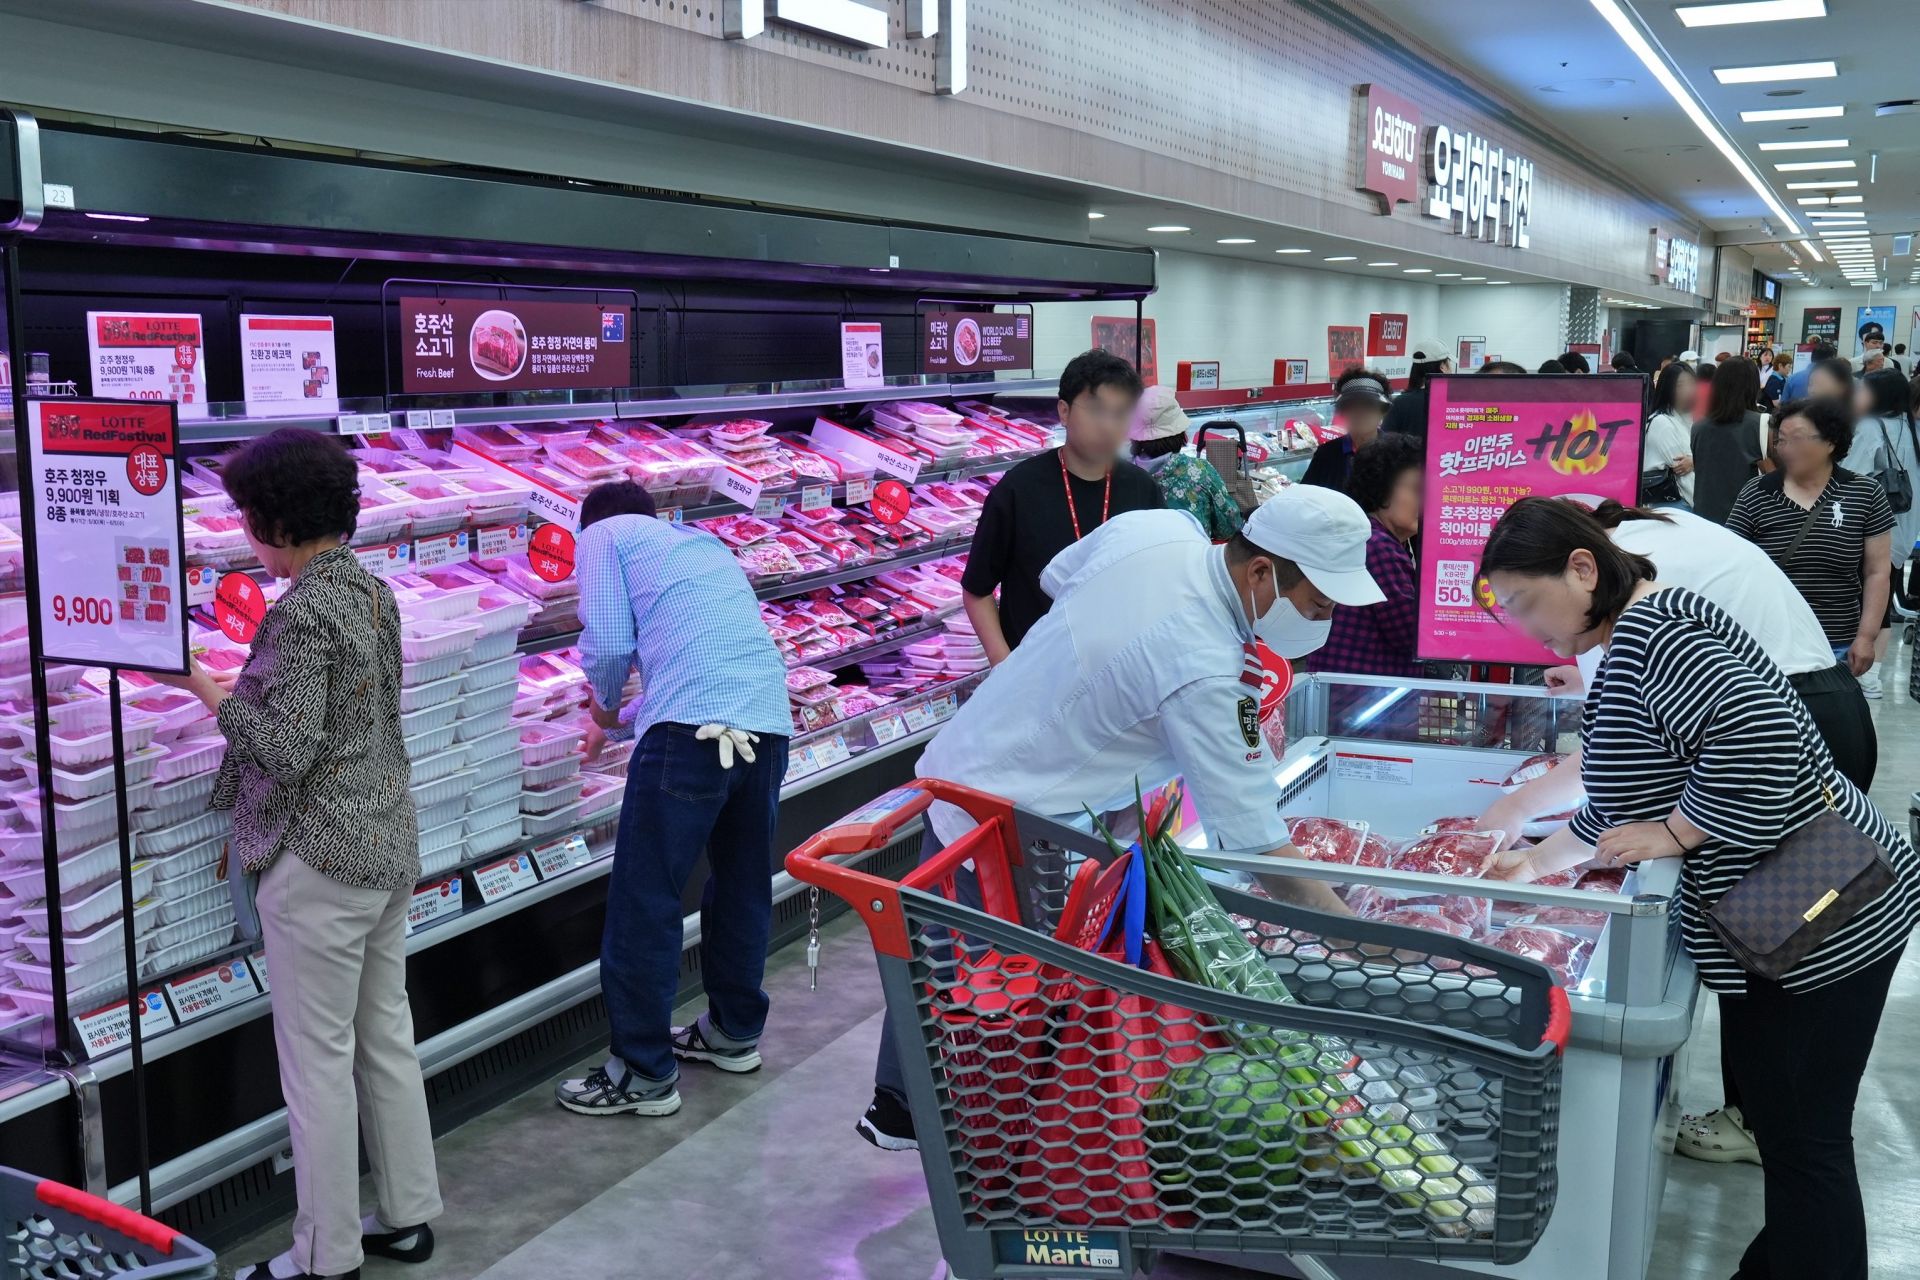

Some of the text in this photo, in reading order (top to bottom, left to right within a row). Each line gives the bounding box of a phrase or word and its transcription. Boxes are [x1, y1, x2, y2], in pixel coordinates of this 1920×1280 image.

[1372, 106, 1416, 162] 요리하다
[52, 189, 66, 203] 23
[146, 322, 180, 330] LOTTE
[414, 313, 454, 334] 호주산
[930, 321, 948, 336] 미국산
[982, 326, 1014, 336] WORLD CLASS
[415, 337, 454, 358] 소고기
[532, 336, 598, 350] 호주 청정 자연의 풍미
[930, 336, 948, 350] 소고기
[990, 336, 1002, 346] BEEF
[100, 355, 135, 364] 호주 청정우
[250, 349, 292, 360] 친환경 에코팩
[100, 366, 155, 376] 9,900원 기획 8종
[416, 367, 454, 378] Fresh Beef
[102, 416, 146, 428] LOTTE
[83, 430, 167, 442] RedFestival
[1464, 433, 1514, 454] 이번주
[134, 452, 160, 470] 대표
[877, 452, 914, 474] 미국산 소고기
[1440, 450, 1527, 478] 핫프라이스
[44, 468, 108, 486] 호주 청정우
[134, 470, 160, 487] 상품
[726, 478, 752, 496] 청정와규
[1442, 486, 1465, 494] 소고기
[46, 488, 120, 506] 9,900원 기획
[529, 491, 576, 520] 호주산 소고기
[1440, 506, 1505, 520] 호주청정우
[47, 506, 67, 522] 8종
[128, 510, 145, 519] 소고기
[541, 560, 558, 576] 파격
[1438, 586, 1470, 603] 50%
[52, 595, 113, 626] 9,900
[226, 614, 245, 637] 파격
[178, 986, 218, 1006] 표시된 가격에서
[182, 994, 222, 1014] 자동할인됩니다
[87, 1026, 108, 1040] 표시된
[1024, 1229, 1089, 1244] LOTTE
[1026, 1244, 1091, 1266] Mart
